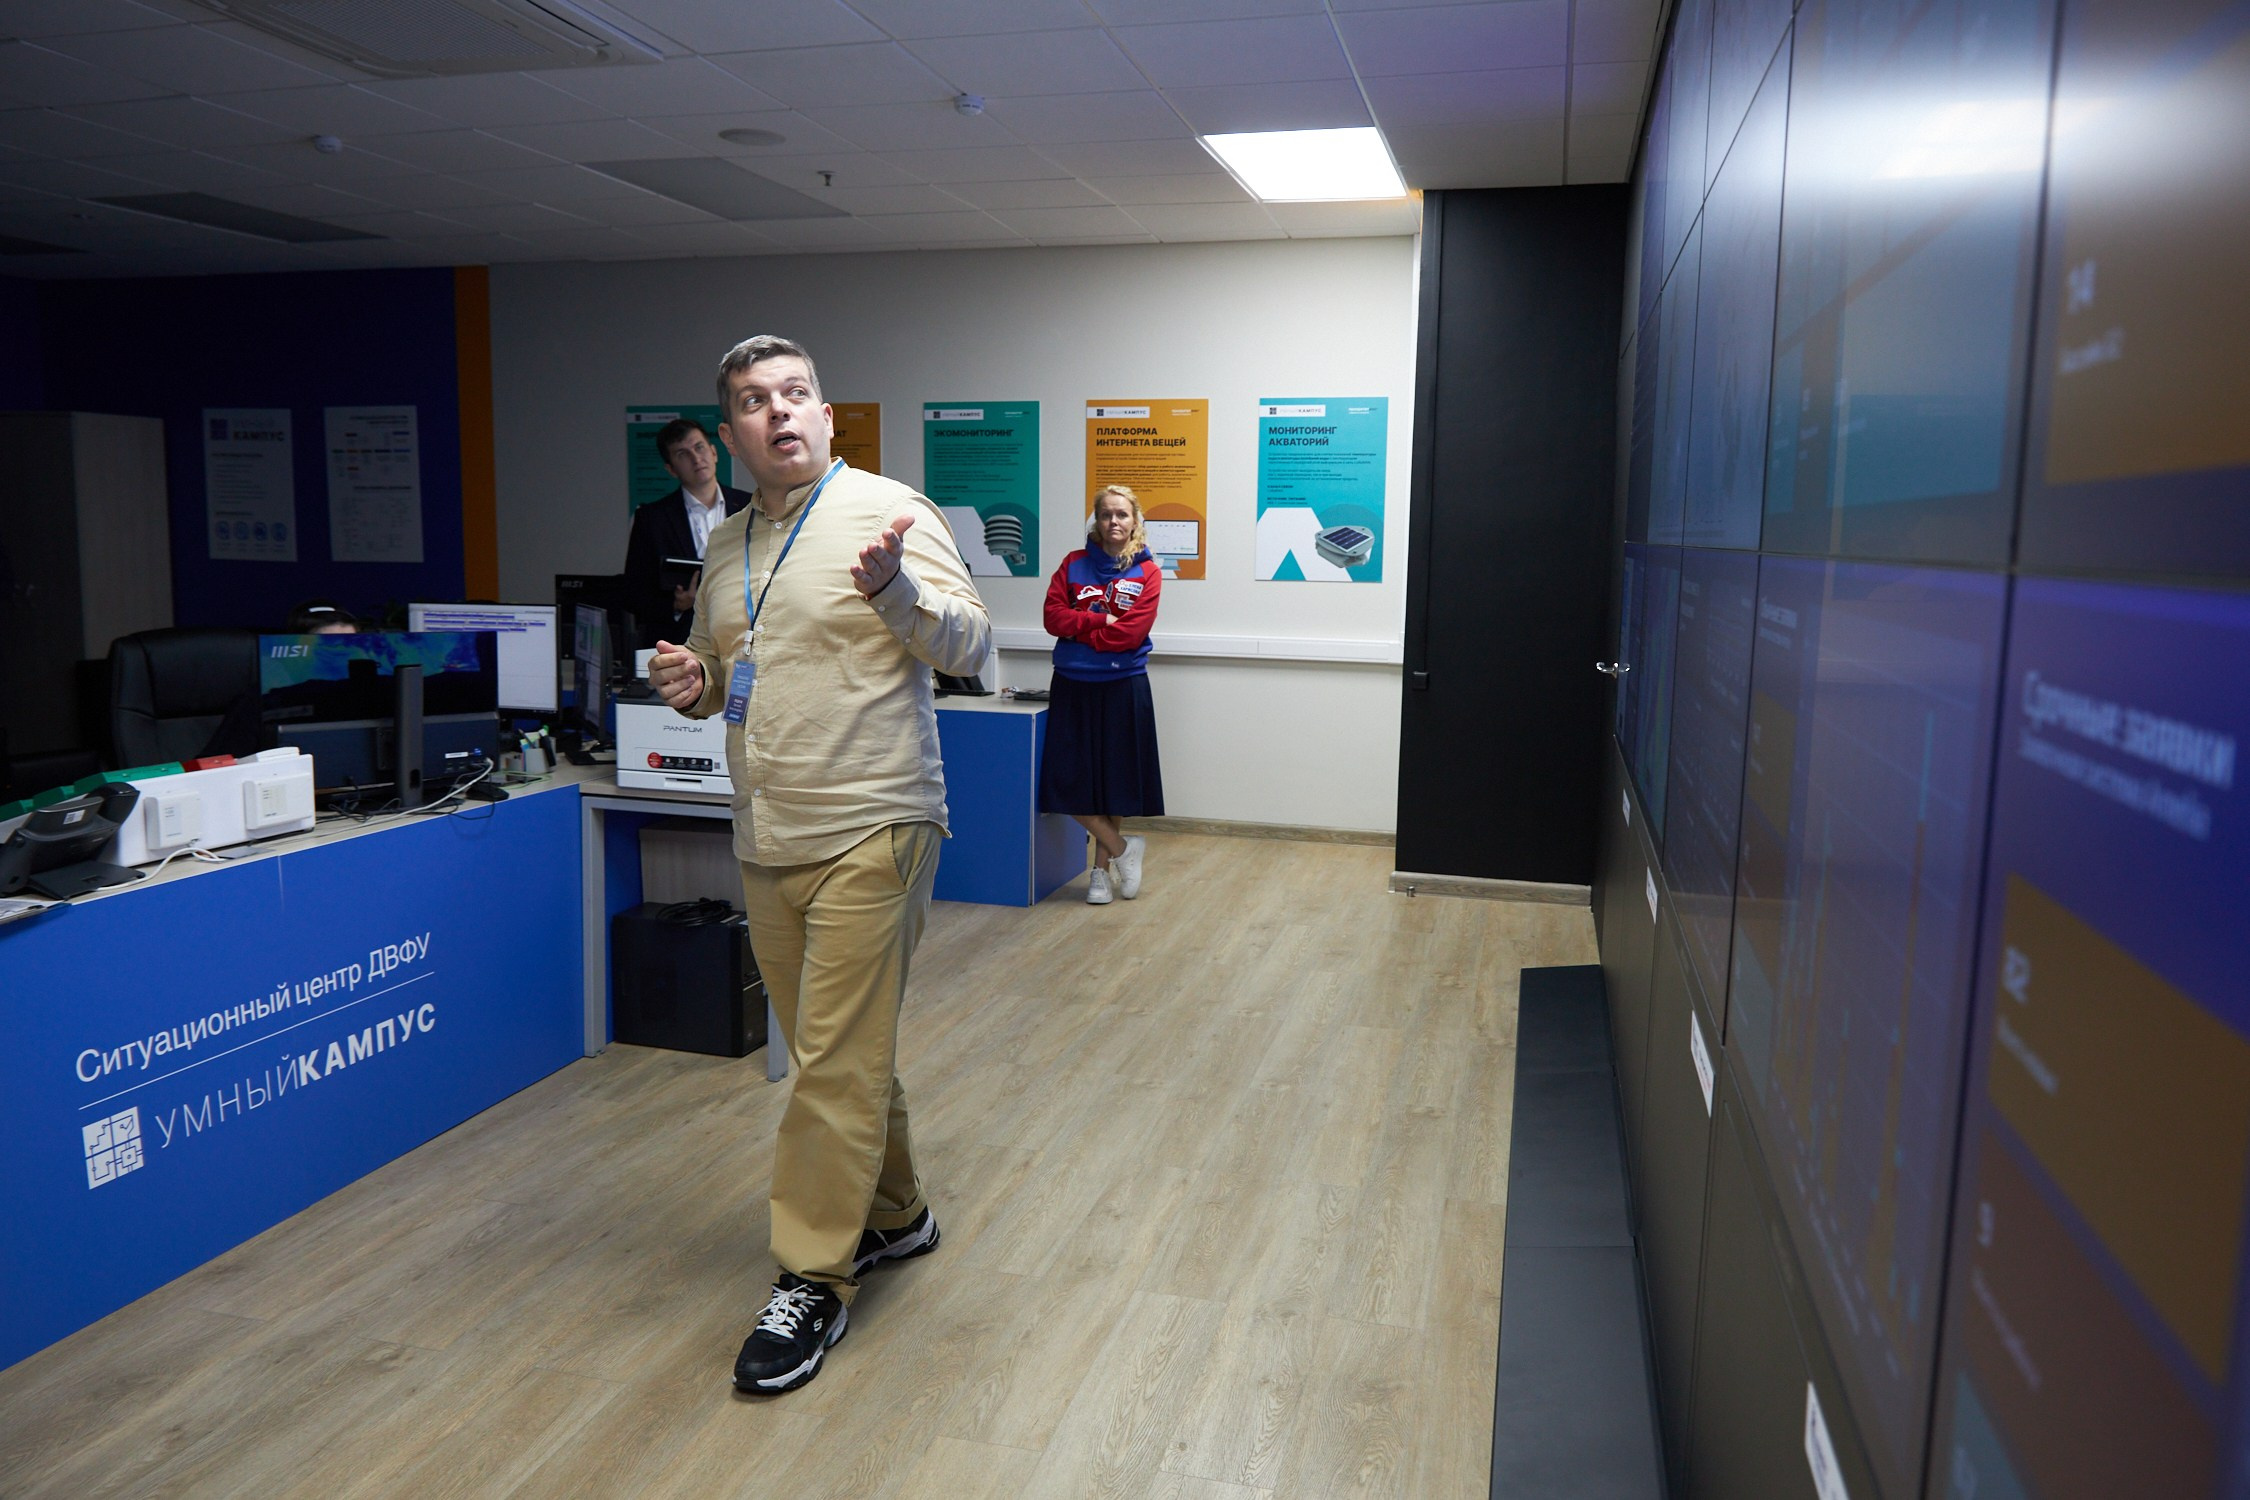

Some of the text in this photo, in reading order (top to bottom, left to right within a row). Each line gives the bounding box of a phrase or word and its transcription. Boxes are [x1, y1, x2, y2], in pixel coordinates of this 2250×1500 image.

[933, 429, 1015, 438] ЭКОМОНИТОРИНГ
[1096, 427, 1158, 436] ПЛАТФОРМА
[1268, 426, 1338, 435] МОНИТОРИНГ
[232, 431, 285, 442] КАМПУС
[1268, 436, 1330, 446] АКВАТОРИЙ
[1096, 437, 1186, 448] ИНТЕРНЕТА ВЕЩЕЙ
[271, 644, 309, 658] MSI
[663, 725, 703, 733] PANTUM
[75, 931, 431, 1083] Ситуационный центр ДВФУ
